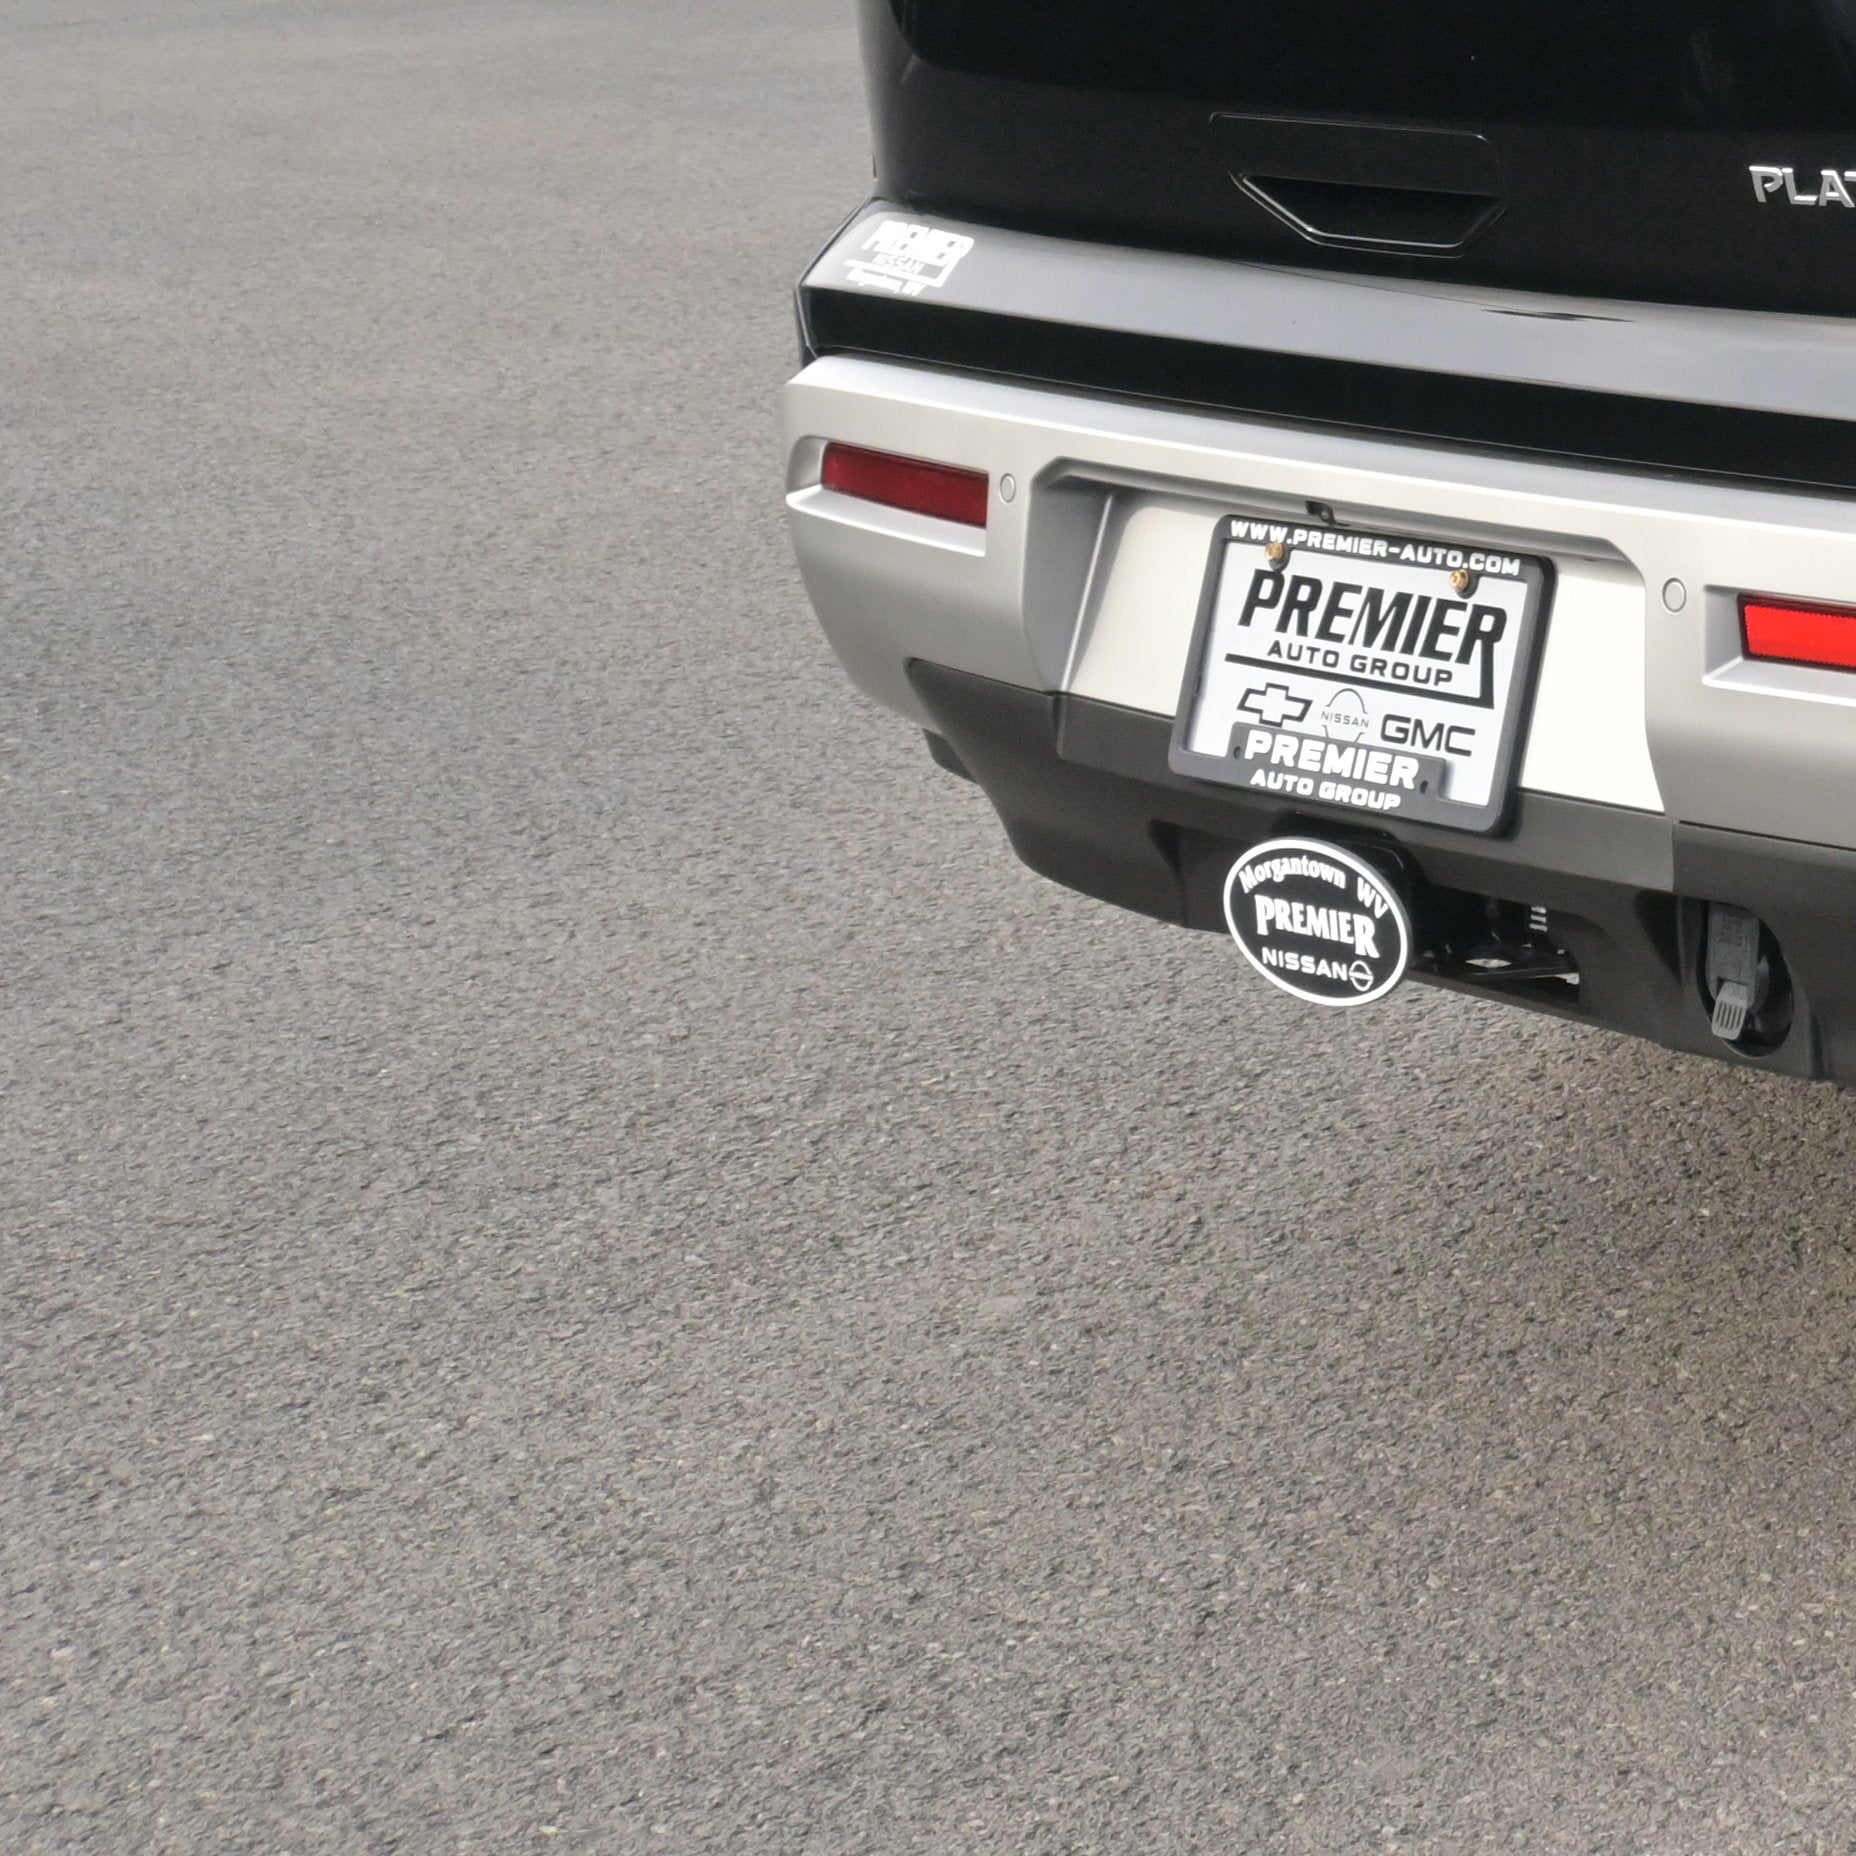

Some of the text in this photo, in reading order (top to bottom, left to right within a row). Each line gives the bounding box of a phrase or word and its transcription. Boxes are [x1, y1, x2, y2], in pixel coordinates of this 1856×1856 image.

[1231, 519, 1520, 576] WWW.PREMIER-AUTO.COM
[1237, 568, 1507, 666] PREMIER
[1267, 640, 1453, 687] AUTO GROUP
[1321, 711, 1369, 729] NISSAN
[1380, 713, 1476, 757] GMC
[1244, 730, 1420, 790] PREMIER
[1250, 768, 1401, 813] AUTO GROUP
[1238, 855, 1389, 919] Morgantown WV
[1254, 894, 1380, 958] PREMIER
[1261, 947, 1348, 981] NISSAN
